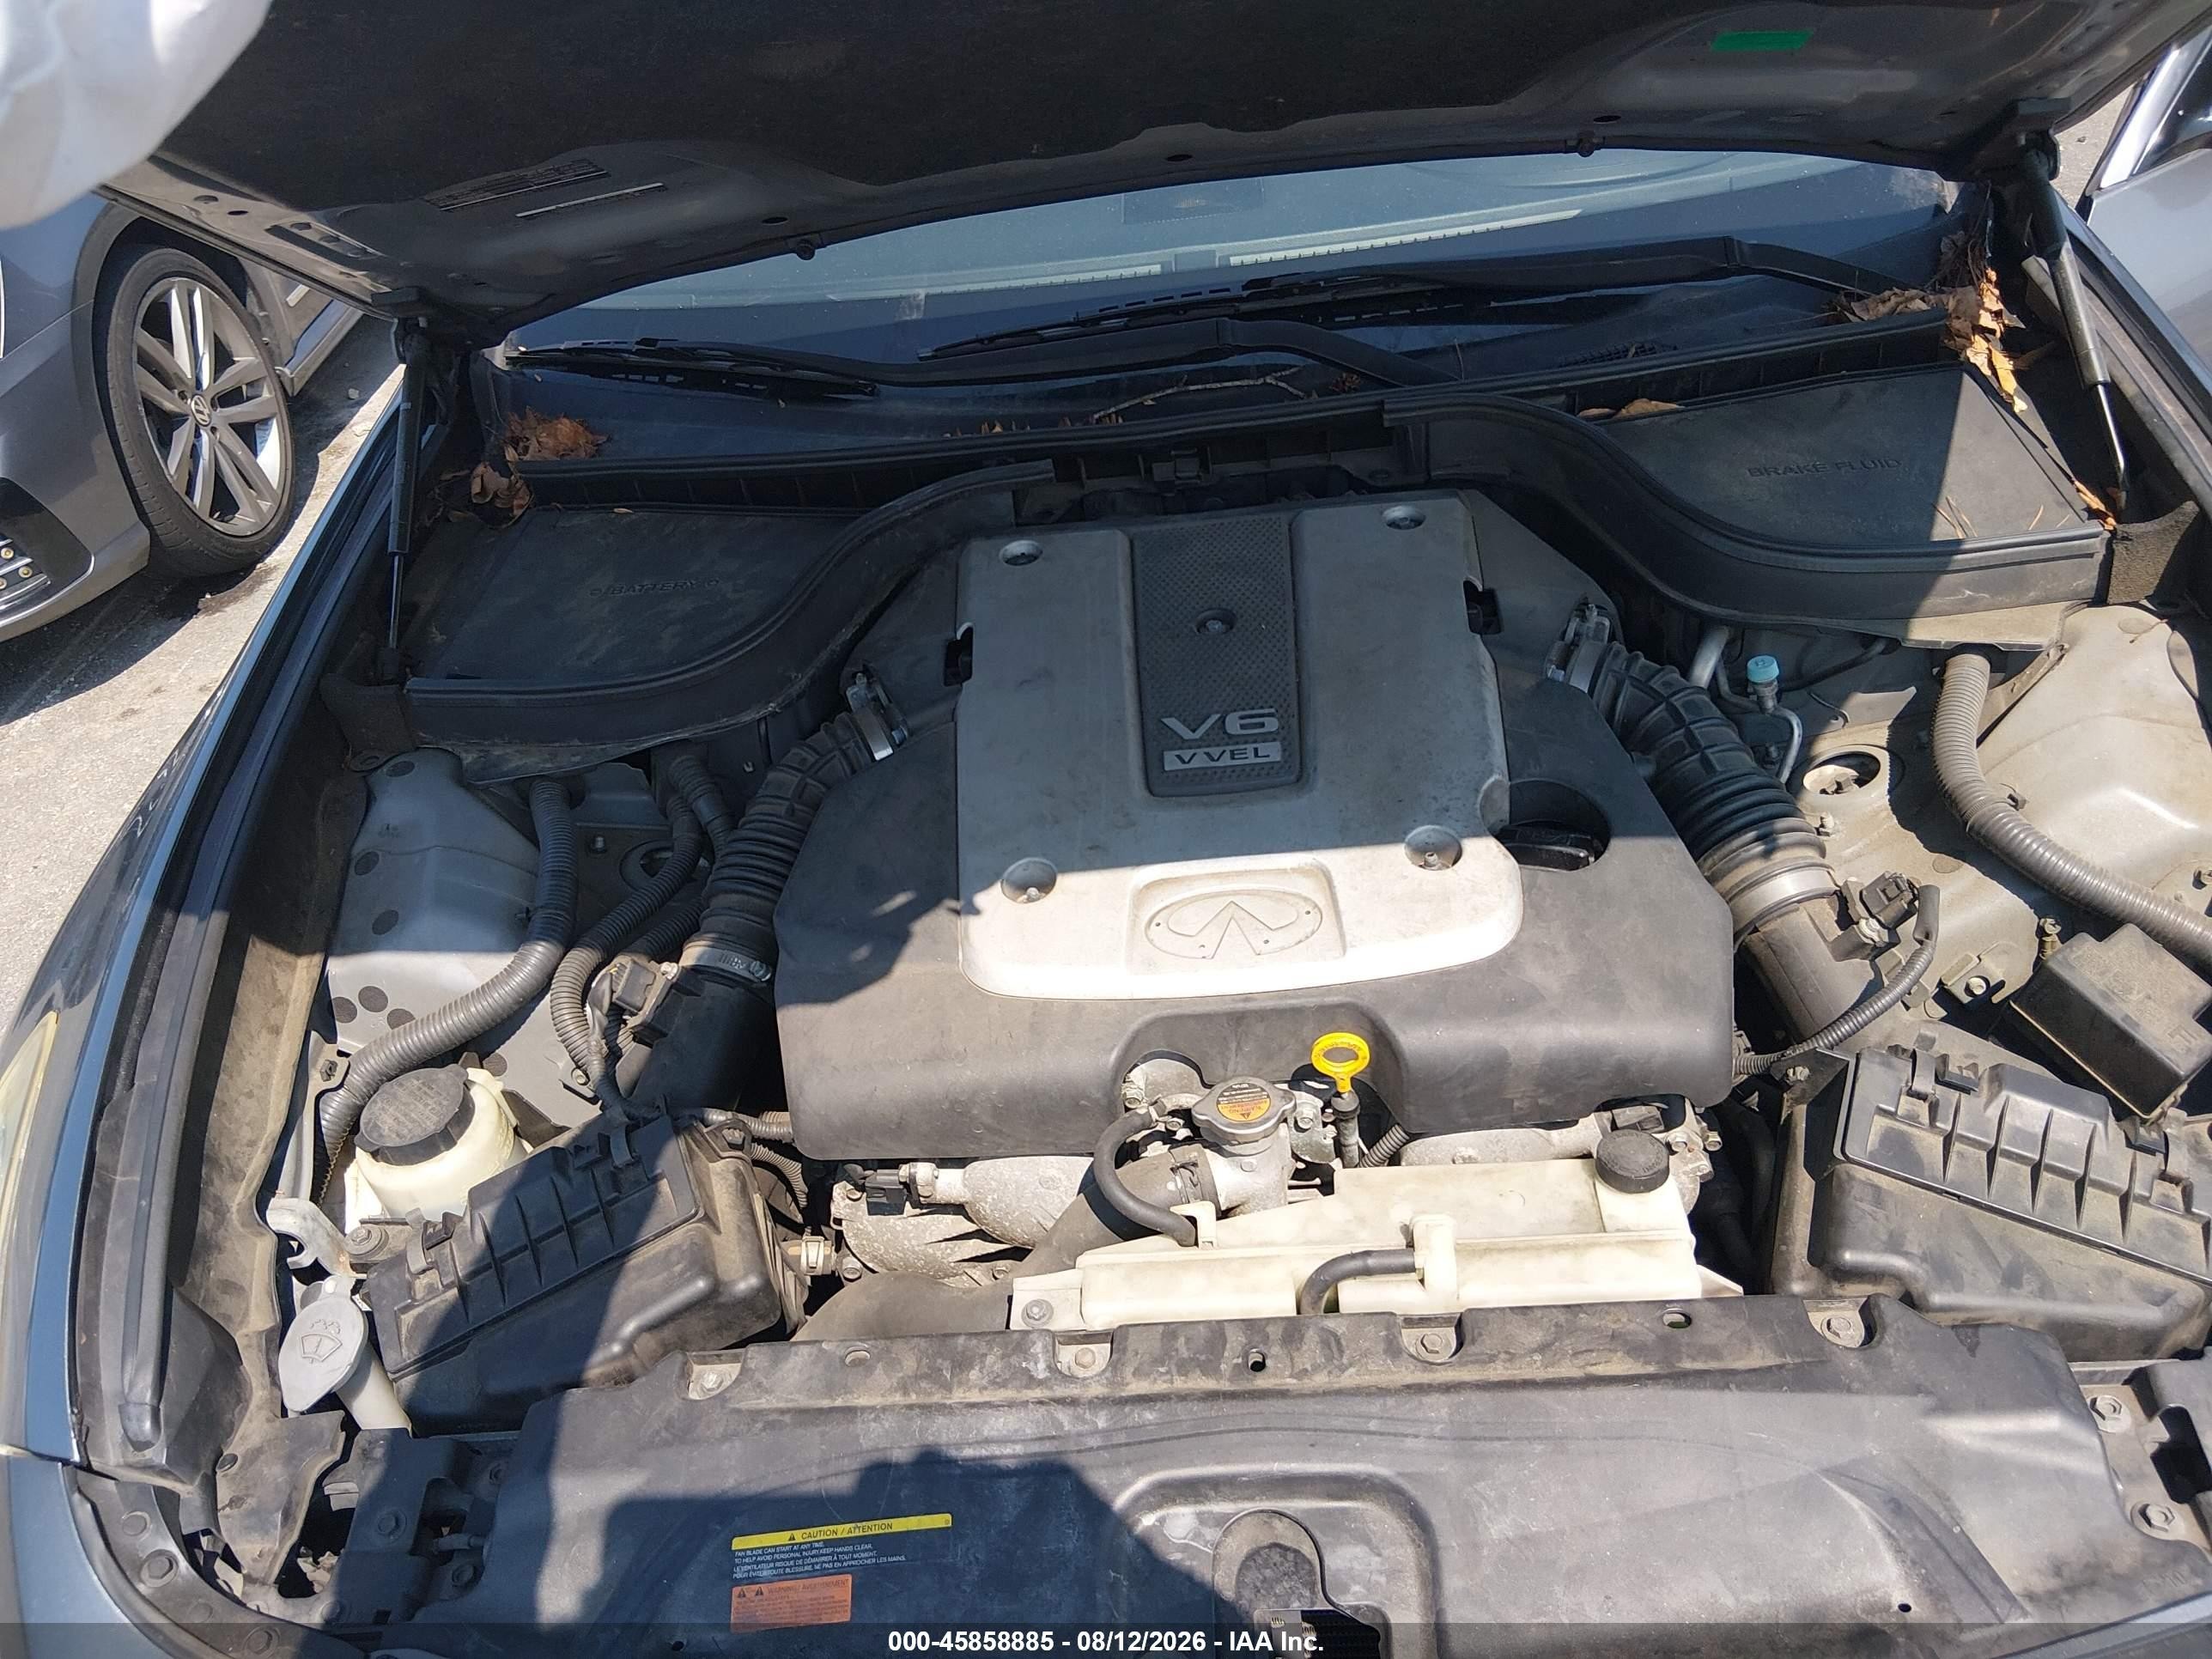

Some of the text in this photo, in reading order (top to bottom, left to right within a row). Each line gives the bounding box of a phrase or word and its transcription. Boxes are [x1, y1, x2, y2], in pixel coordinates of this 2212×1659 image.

[1747, 459, 1903, 477] BRAKE FLUID
[611, 580, 696, 596] BATTERY
[1160, 708, 1279, 740] V6
[1174, 747, 1271, 764] VVEL
[800, 1528, 838, 1540] CAUTION
[847, 1522, 893, 1535] ATTENTION
